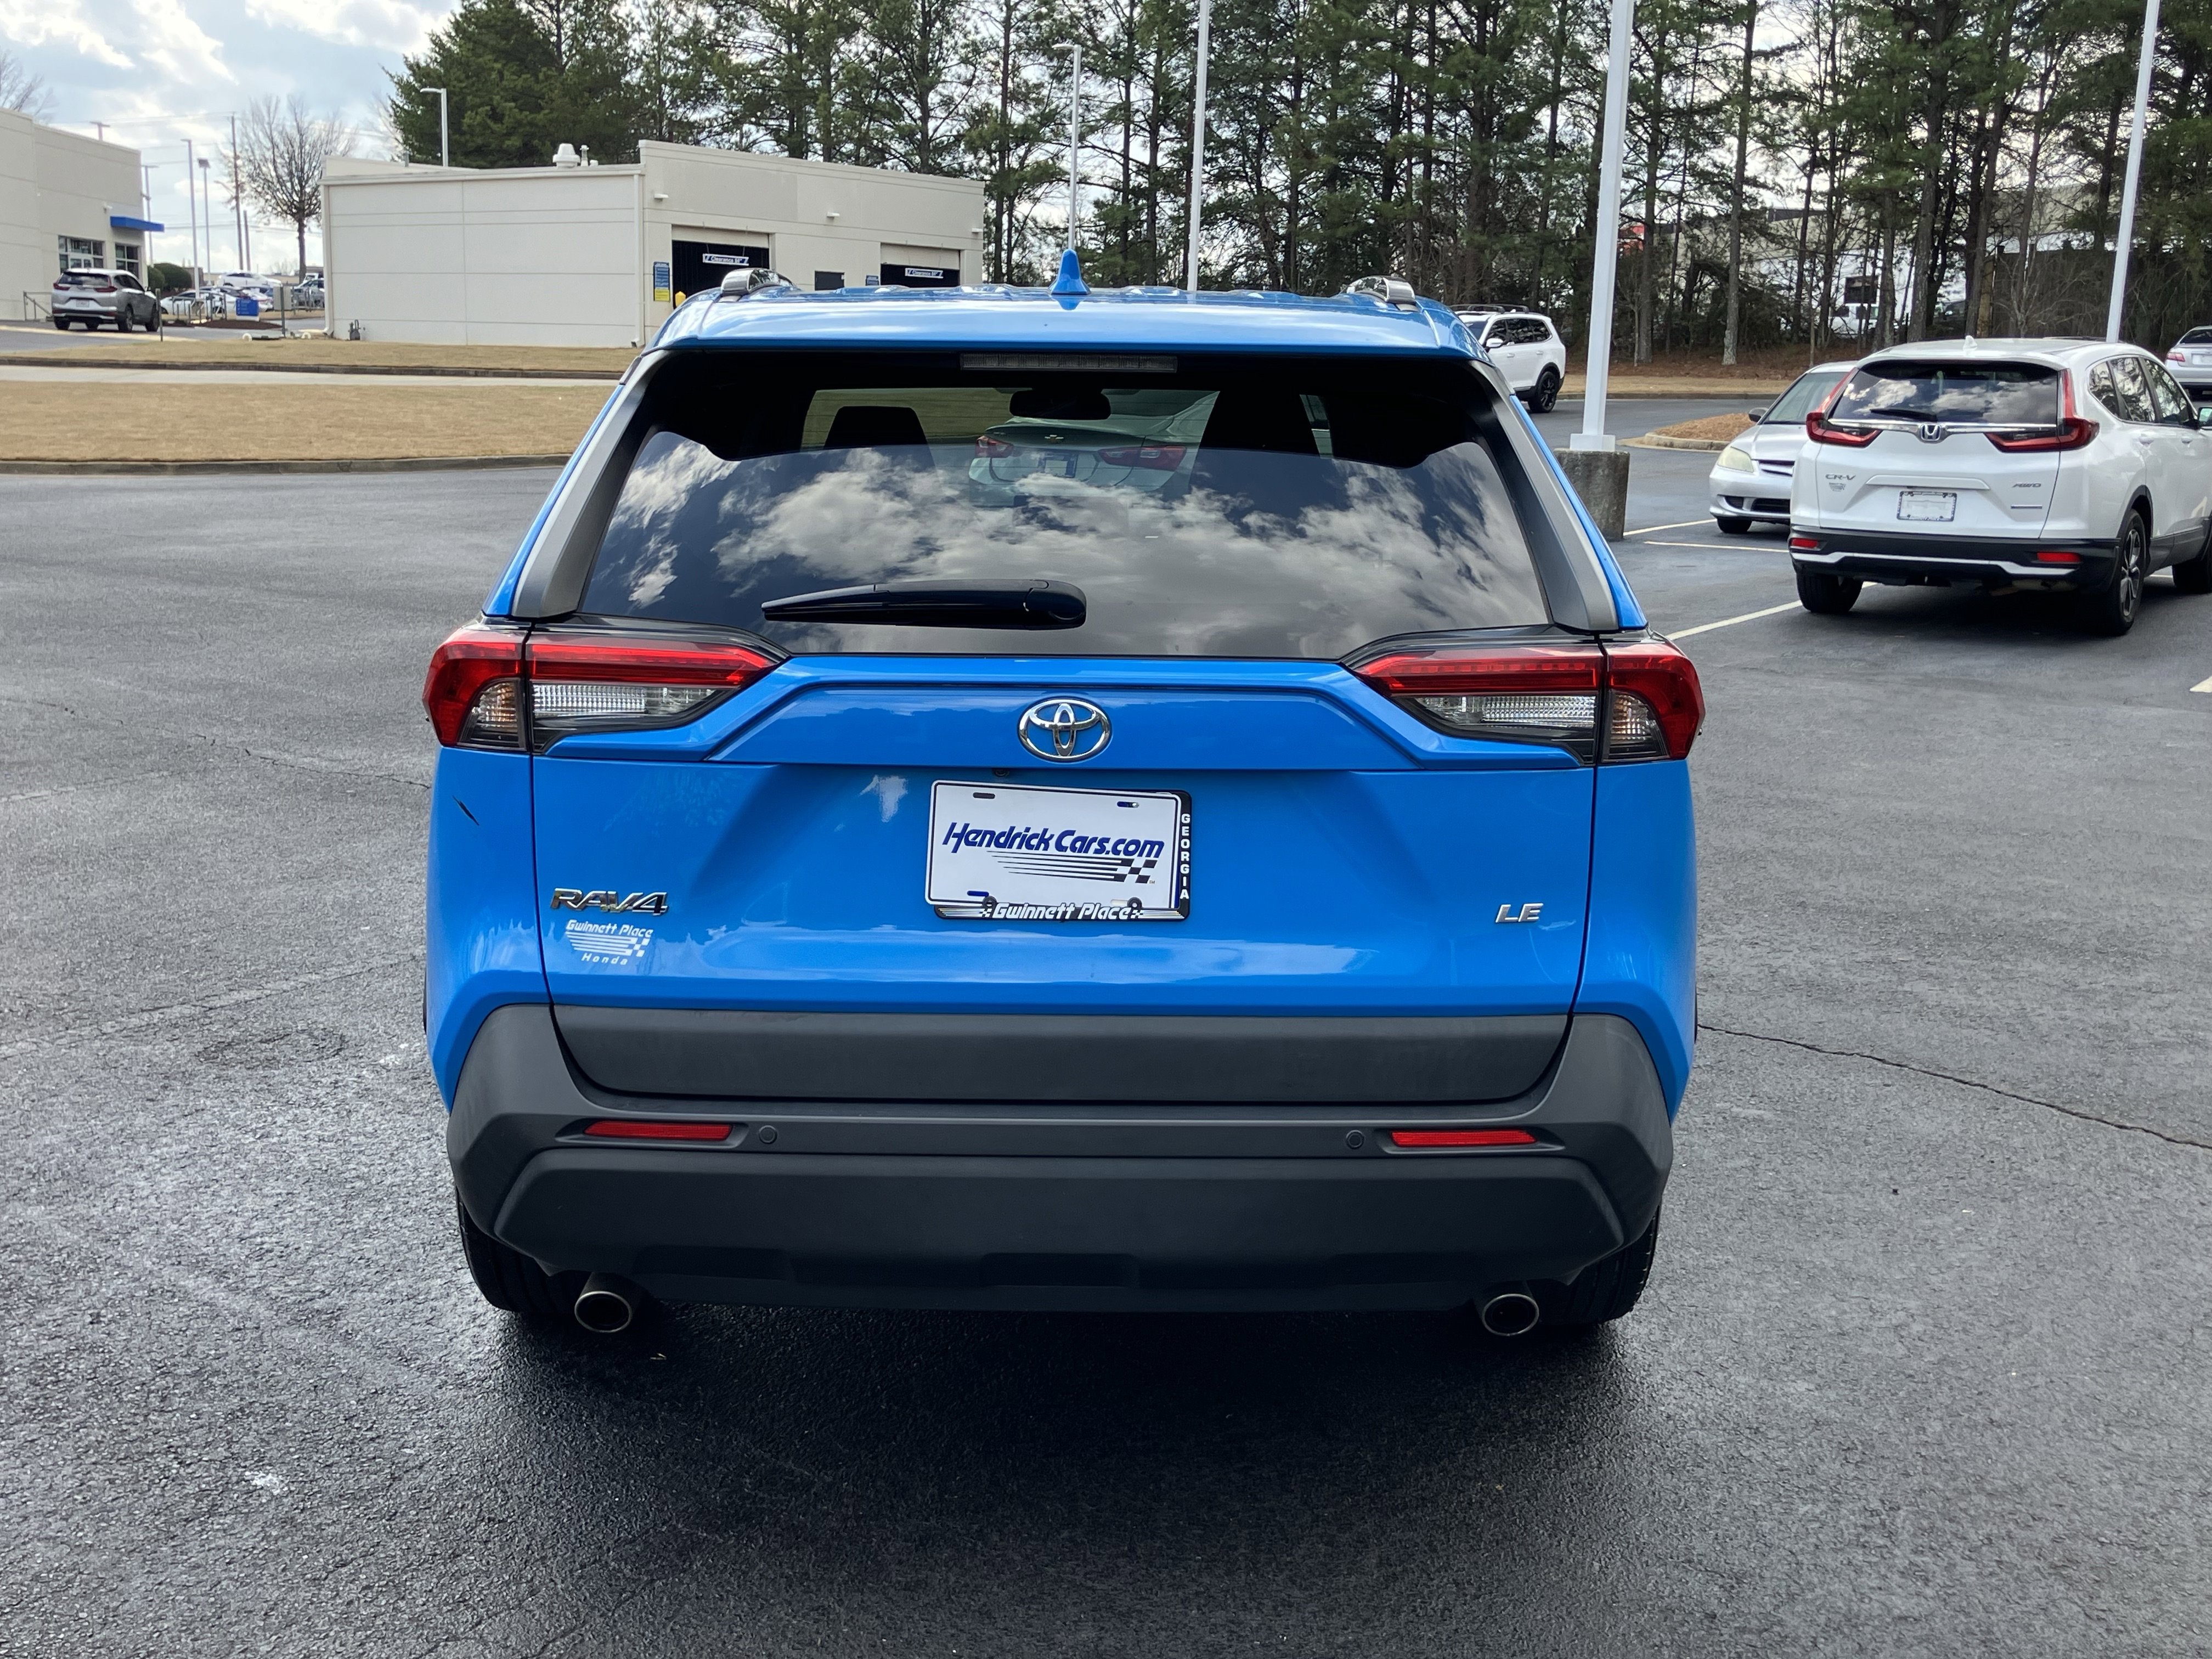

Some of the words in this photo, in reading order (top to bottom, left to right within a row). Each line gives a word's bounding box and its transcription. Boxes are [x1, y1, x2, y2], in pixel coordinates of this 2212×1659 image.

[1180, 813, 1191, 900] GEORGIA
[550, 888, 668, 916] RAV4
[992, 902, 1076, 919] Gwinnett
[1078, 902, 1132, 919] Place
[1495, 902, 1544, 923] LE
[566, 919, 618, 934] Gwinnett
[618, 924, 654, 938] Place
[581, 952, 628, 966] Honda
